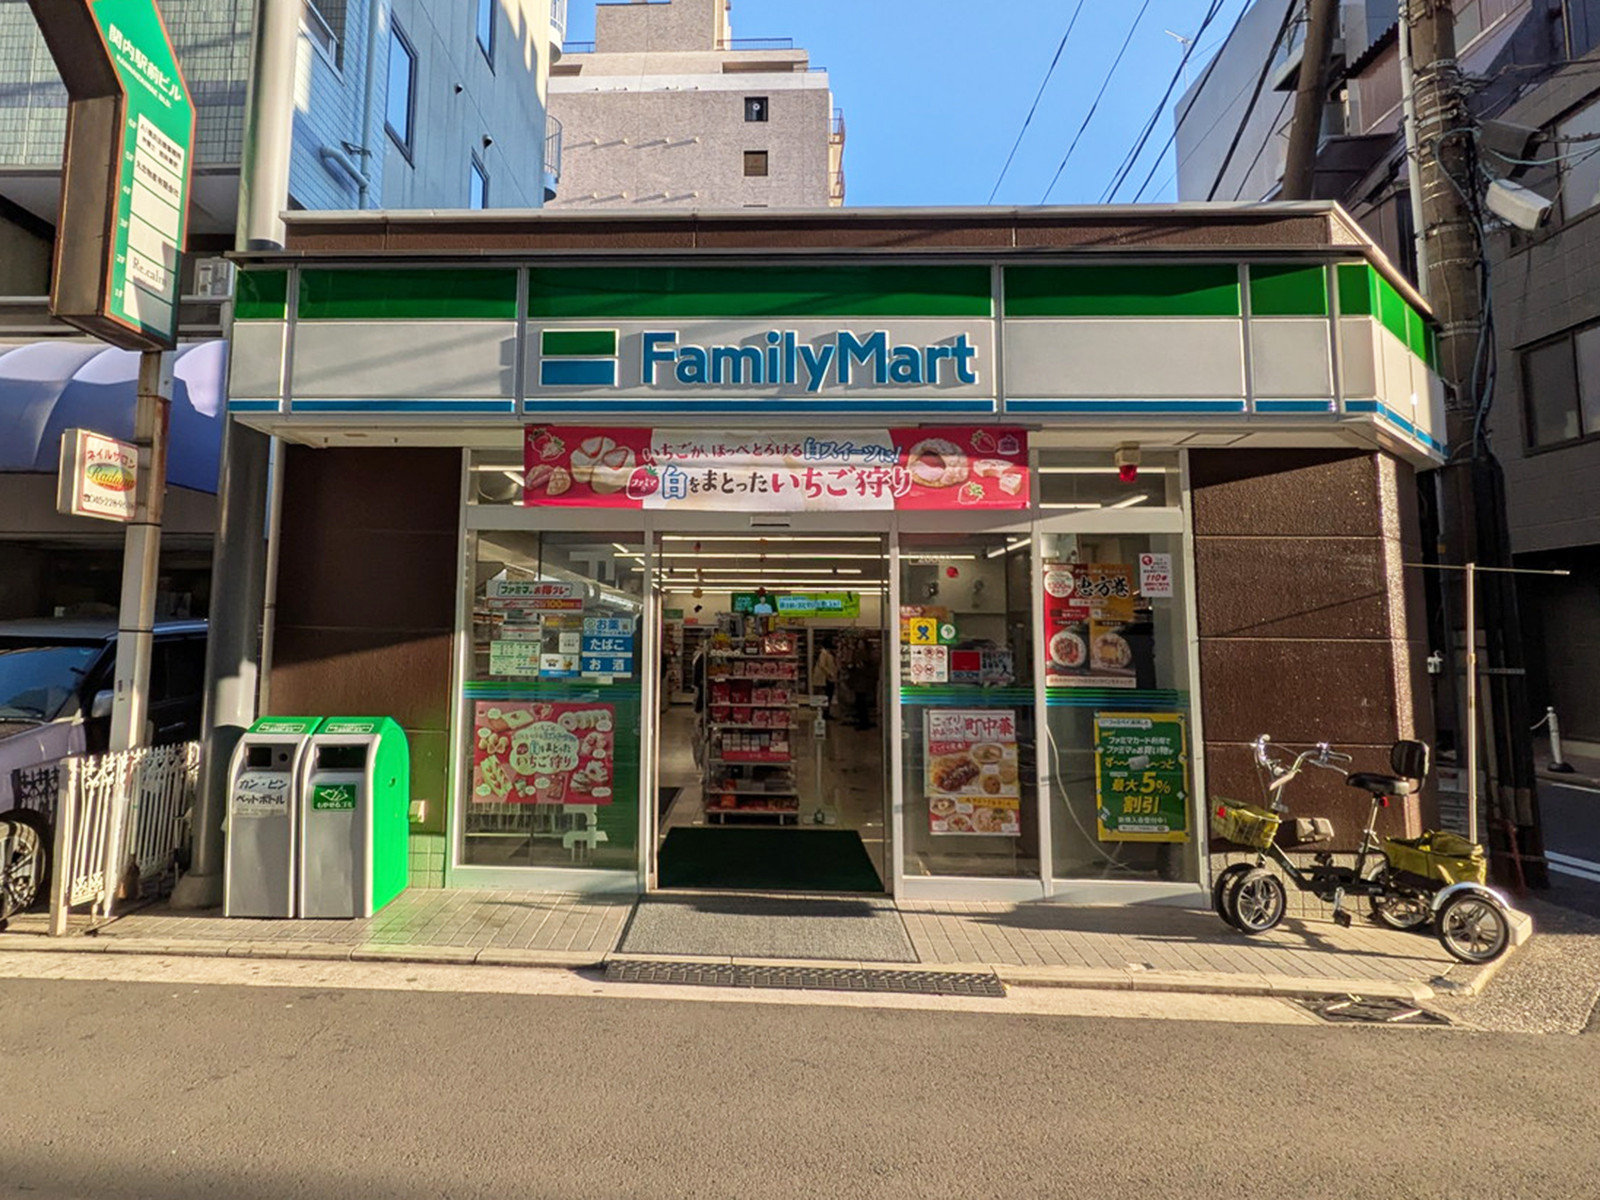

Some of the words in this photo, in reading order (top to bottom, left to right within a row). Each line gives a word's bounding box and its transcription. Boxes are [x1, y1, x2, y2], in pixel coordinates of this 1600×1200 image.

[108, 23, 181, 101] 関内駅前ビル
[642, 330, 978, 392] FamilyMart
[87, 449, 136, 469] ネイルサロン
[1074, 575, 1130, 598] 恵方巻
[596, 619, 619, 630] お薬
[590, 638, 625, 650] たばこ
[964, 715, 1014, 737] 町中華
[1112, 771, 1171, 793] 最大5%
[236, 794, 285, 805] ペットボトル
[1123, 795, 1160, 815] 割引
